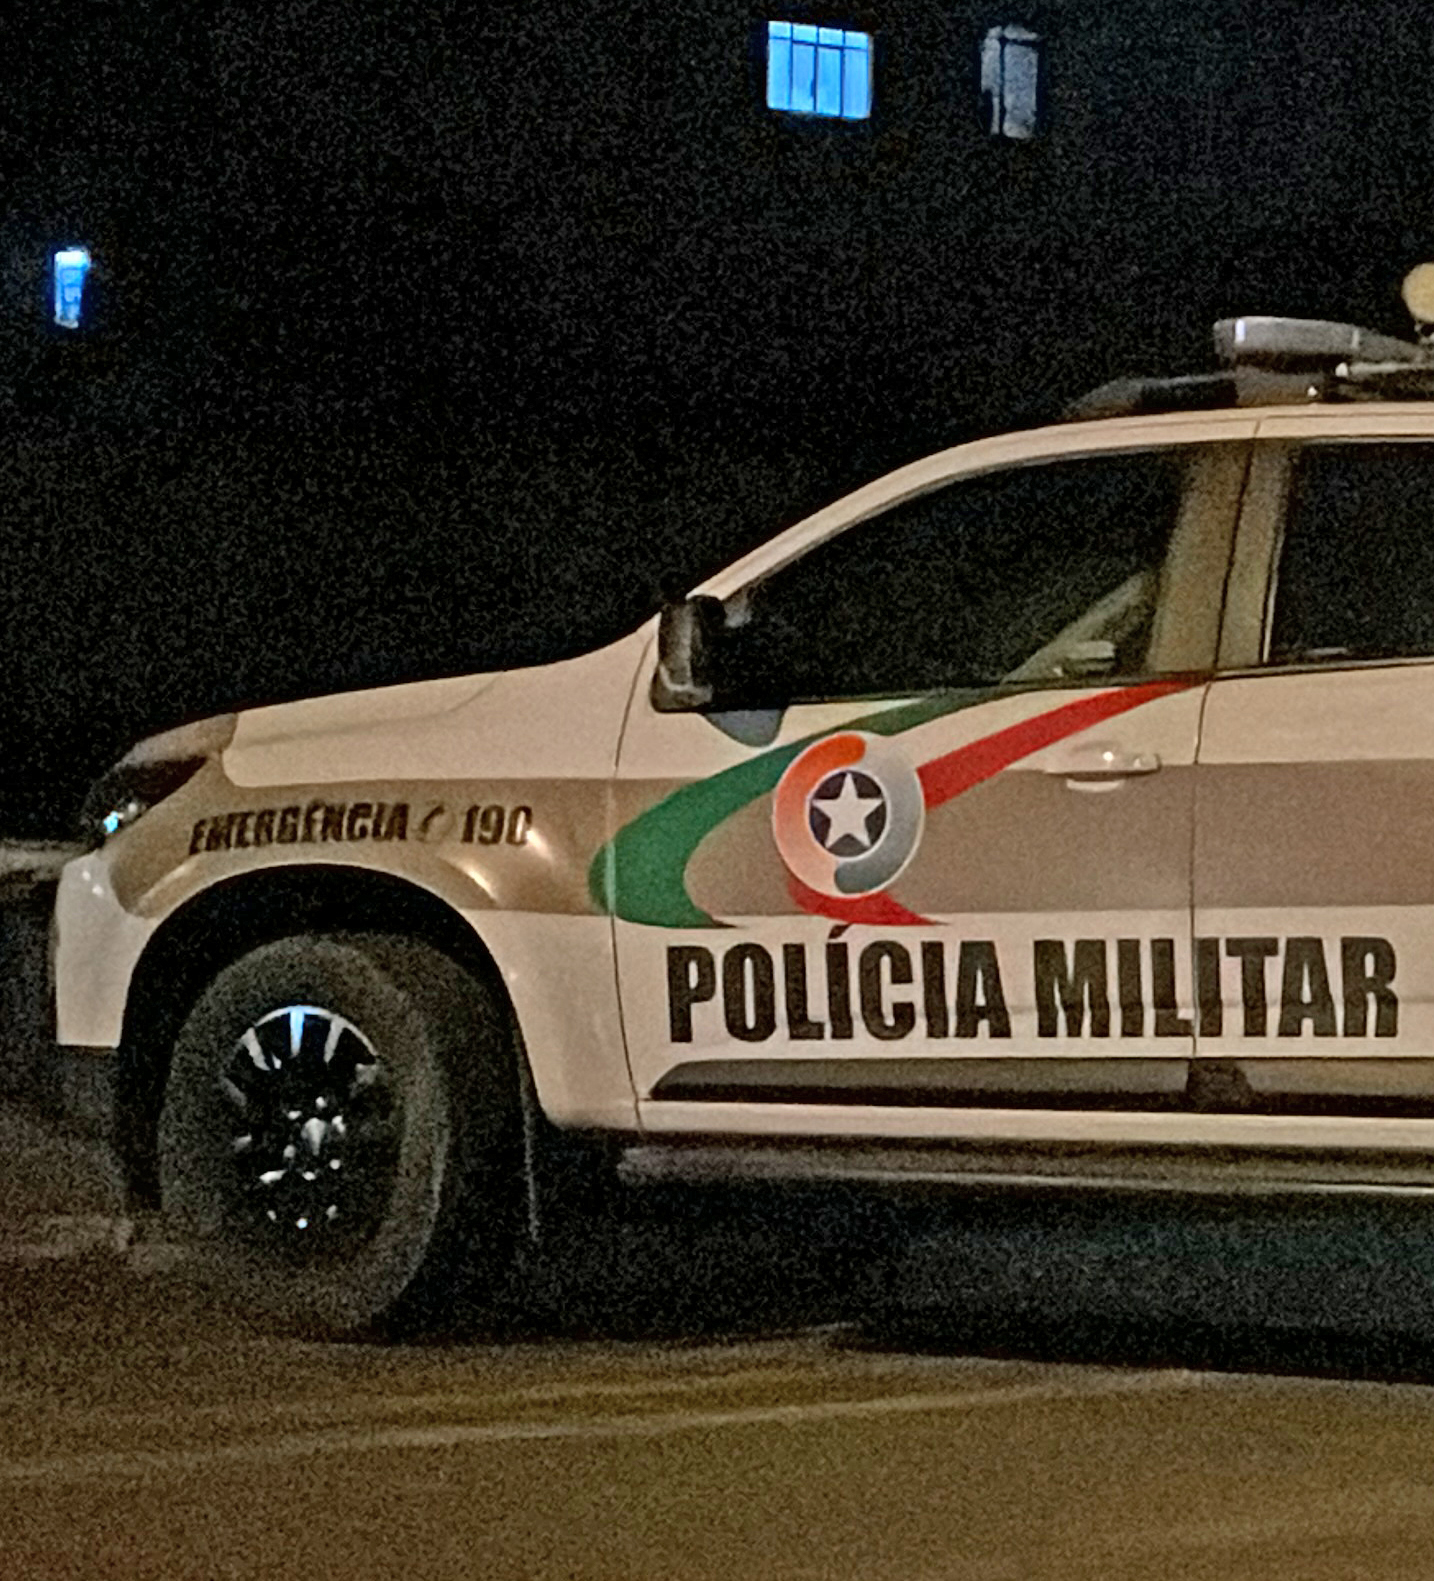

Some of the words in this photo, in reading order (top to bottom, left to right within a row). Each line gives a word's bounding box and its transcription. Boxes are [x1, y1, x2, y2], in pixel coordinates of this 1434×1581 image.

[189, 799, 410, 856] EMERGÊNCIA
[461, 803, 533, 847] 190
[665, 922, 1012, 1043] POLÍCIA
[1032, 936, 1400, 1040] MILITAR
